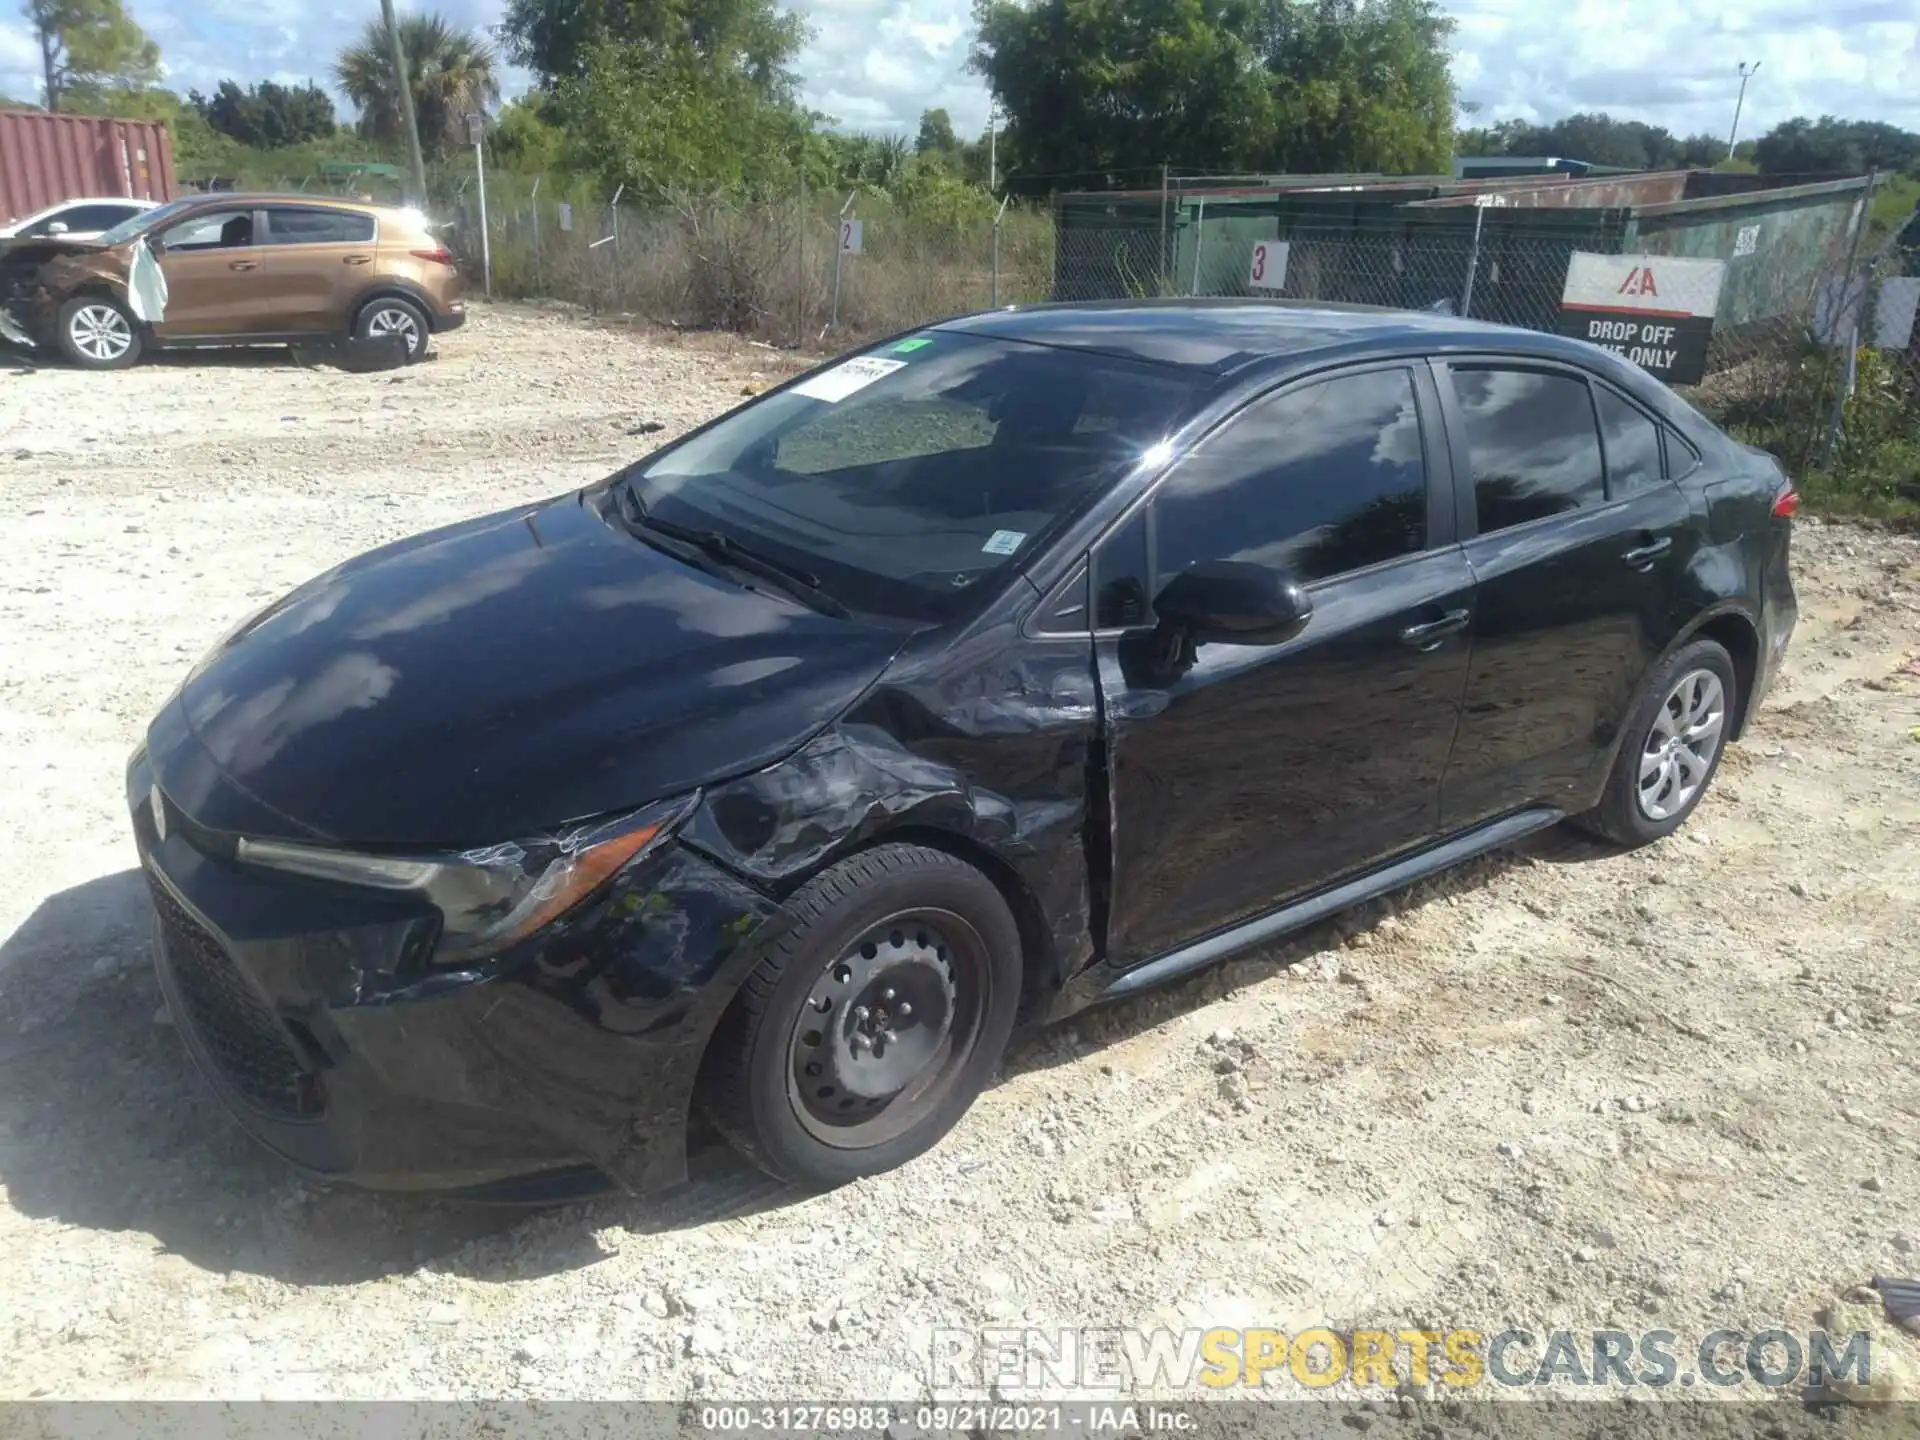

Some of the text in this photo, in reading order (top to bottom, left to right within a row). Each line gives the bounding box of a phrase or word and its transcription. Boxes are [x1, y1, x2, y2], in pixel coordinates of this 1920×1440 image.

[843, 223, 851, 249] 2
[1252, 245, 1266, 281] 3
[1588, 319, 1676, 345] DROP OFF
[1629, 346, 1677, 369] ONLY
